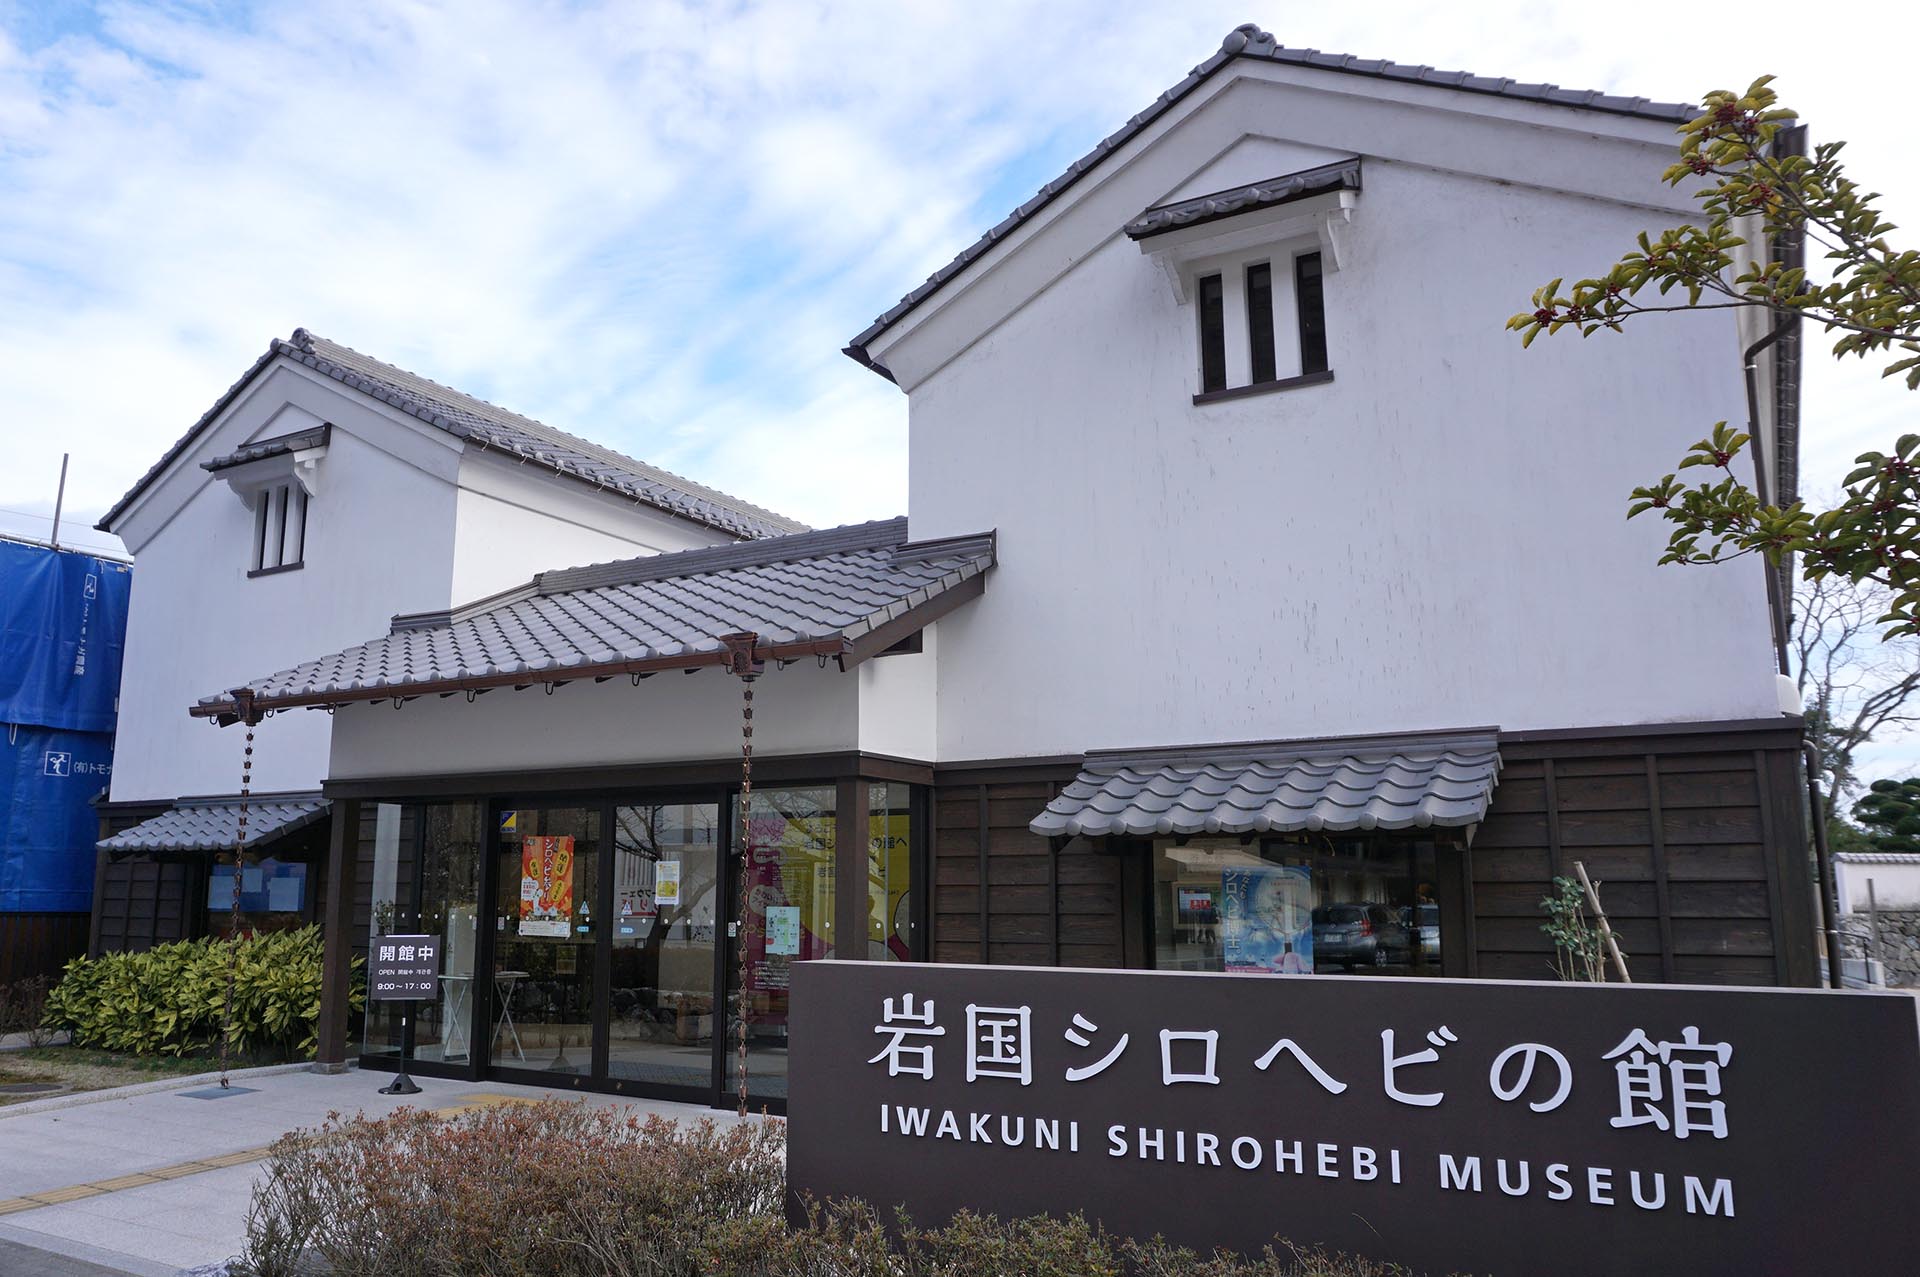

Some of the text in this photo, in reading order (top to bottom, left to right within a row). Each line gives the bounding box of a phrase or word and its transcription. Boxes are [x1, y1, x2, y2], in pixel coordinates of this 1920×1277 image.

[379, 945, 434, 961] 開館中
[867, 991, 1734, 1140] 岩国シロヘビの館
[881, 1104, 1736, 1218] IWAKUNI SHIROHEBI MUSEUM
